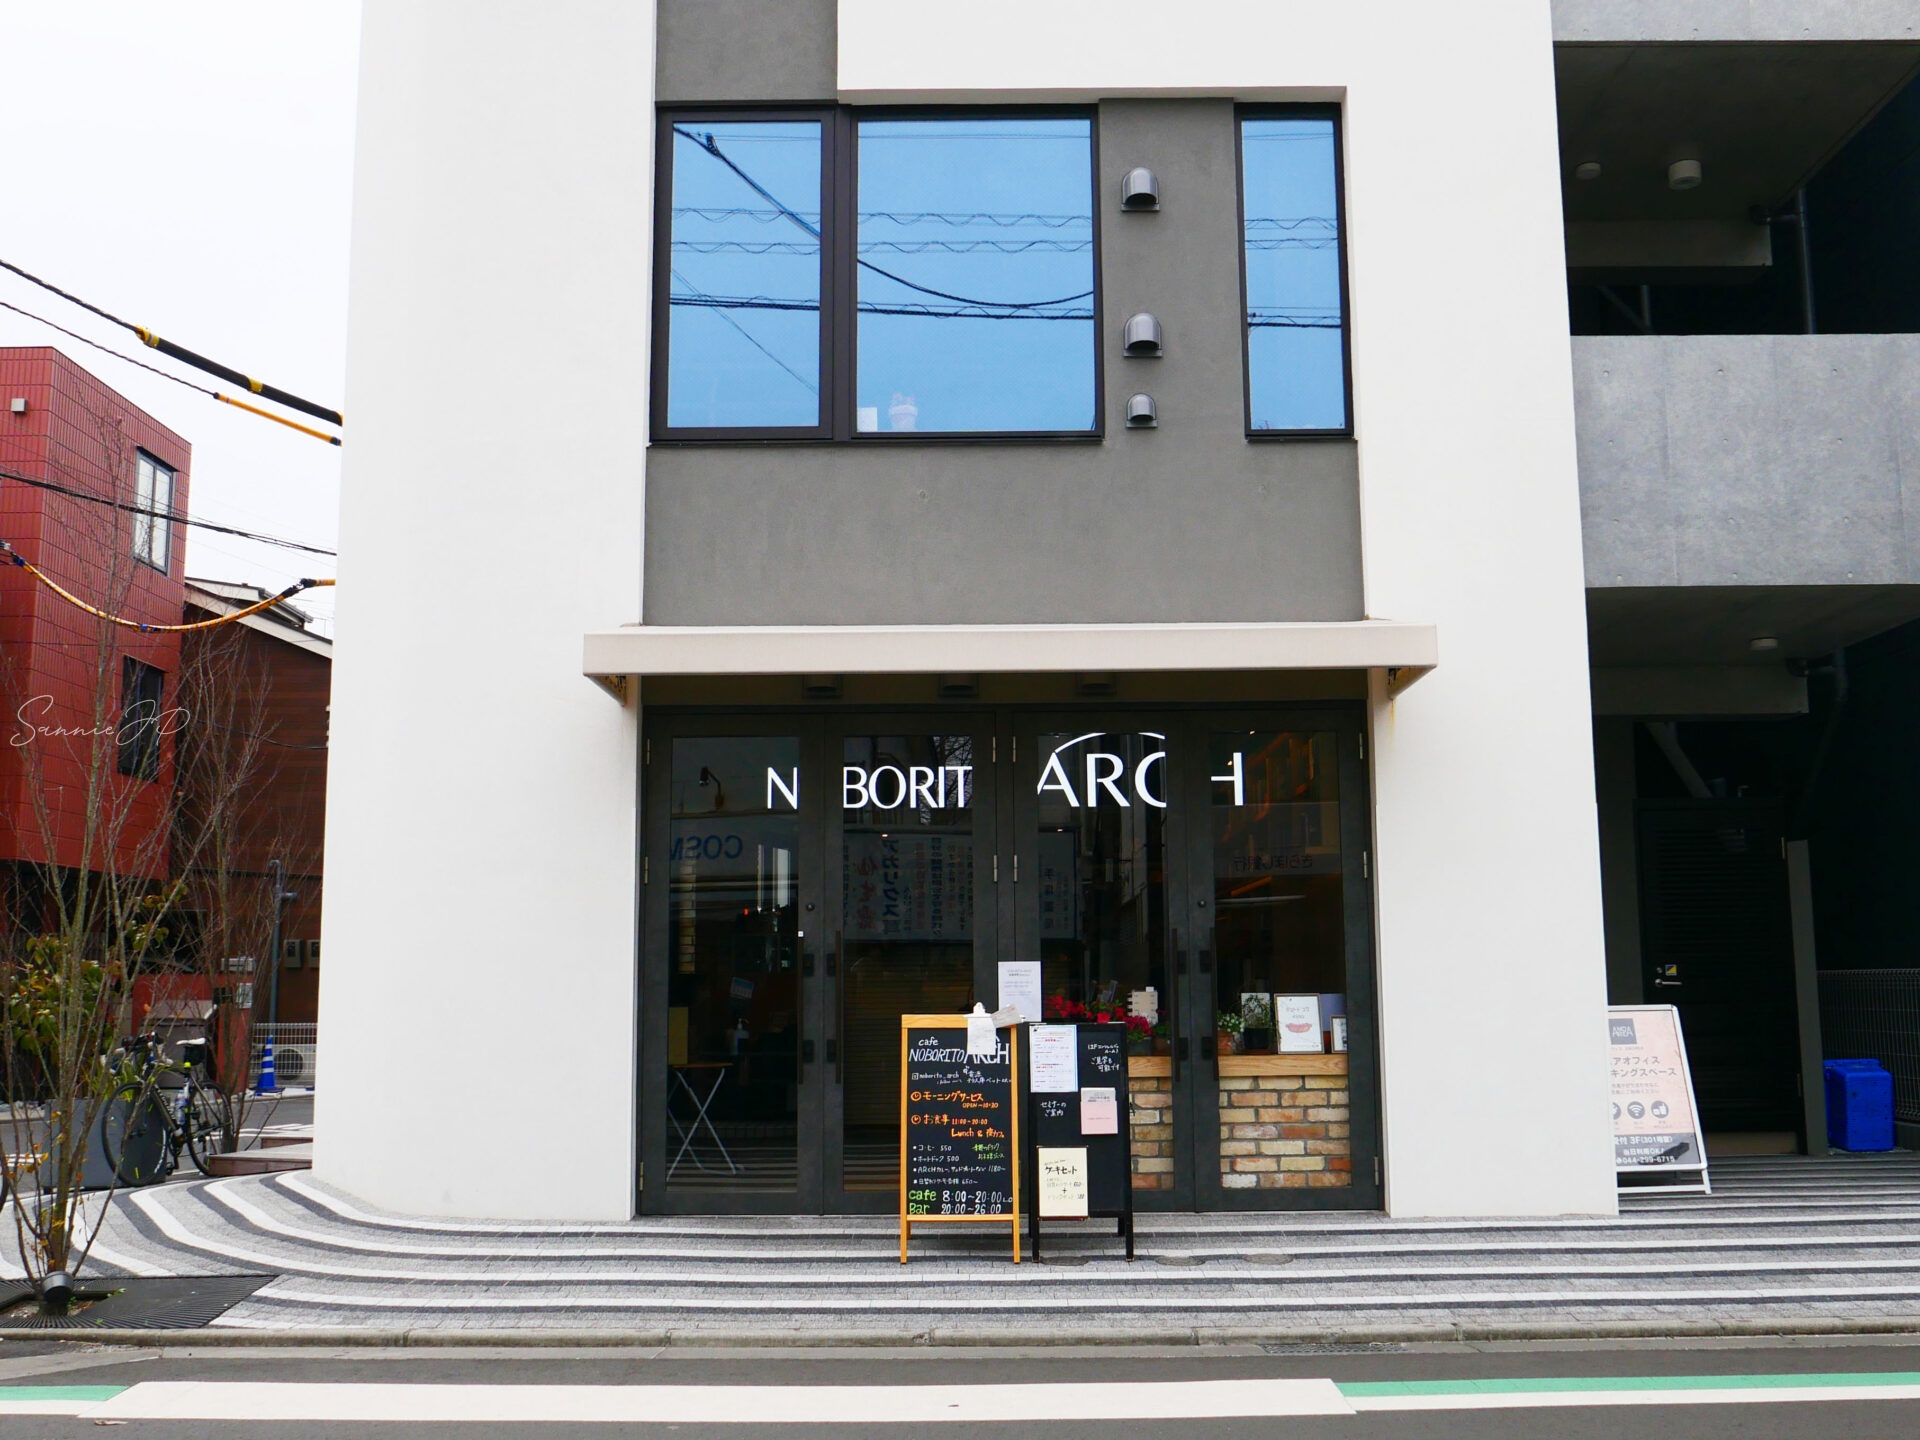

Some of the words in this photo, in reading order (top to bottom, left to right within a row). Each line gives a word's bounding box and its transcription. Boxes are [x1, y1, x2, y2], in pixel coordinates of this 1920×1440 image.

[918, 1036, 939, 1046] cafe
[908, 1048, 965, 1063] NOBORITO
[922, 1090, 984, 1102] モーニングサービス
[1040, 1100, 1067, 1109] セミナーの
[950, 1127, 975, 1138] Lunch
[908, 1189, 937, 1201] cafe
[909, 1202, 930, 1215] Bar
